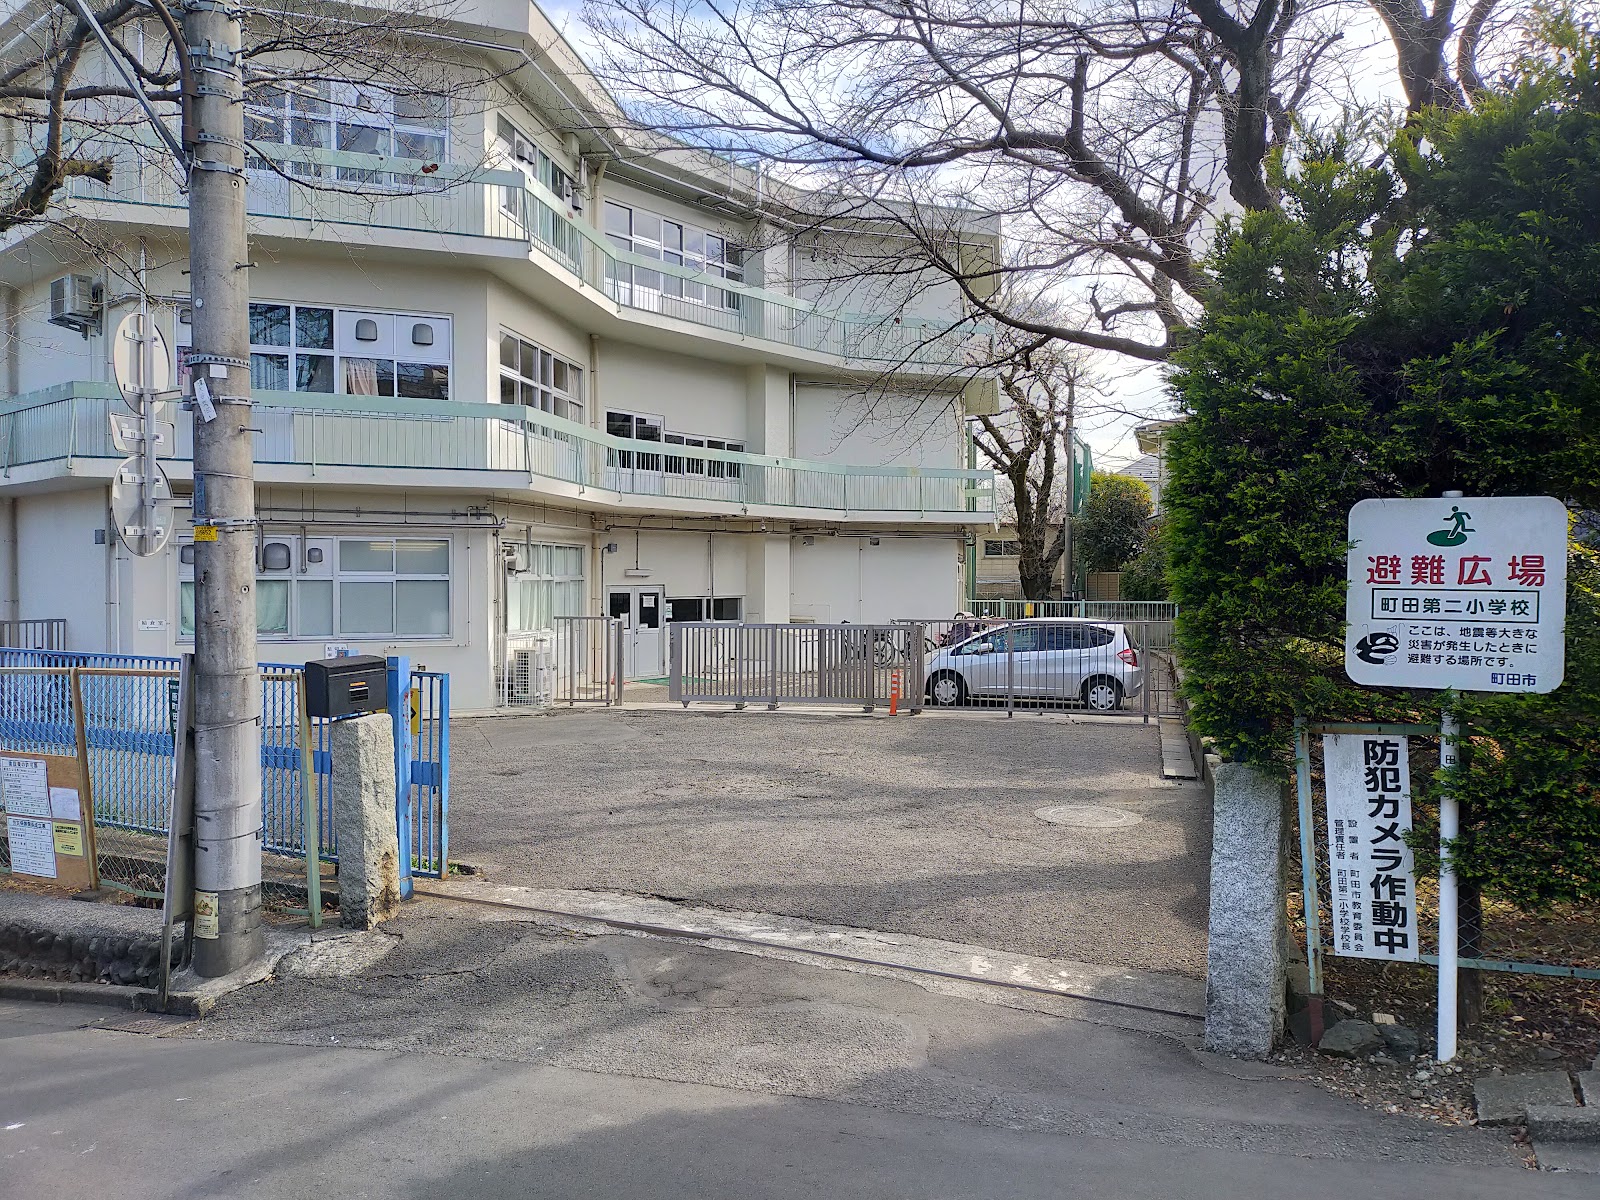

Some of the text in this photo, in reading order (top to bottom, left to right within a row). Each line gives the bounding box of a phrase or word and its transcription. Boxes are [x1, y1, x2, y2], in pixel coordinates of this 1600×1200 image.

[1366, 554, 1546, 587] 避難広場
[1381, 597, 1530, 616] 町田第二小学校
[1408, 625, 1538, 640] ここは、地震等大きな
[1408, 639, 1537, 654] 災害が発生したときに
[1407, 653, 1515, 668] 避難する場所です。
[1491, 672, 1537, 687] 町田市
[1363, 740, 1409, 954] 防犯カメラ作動中
